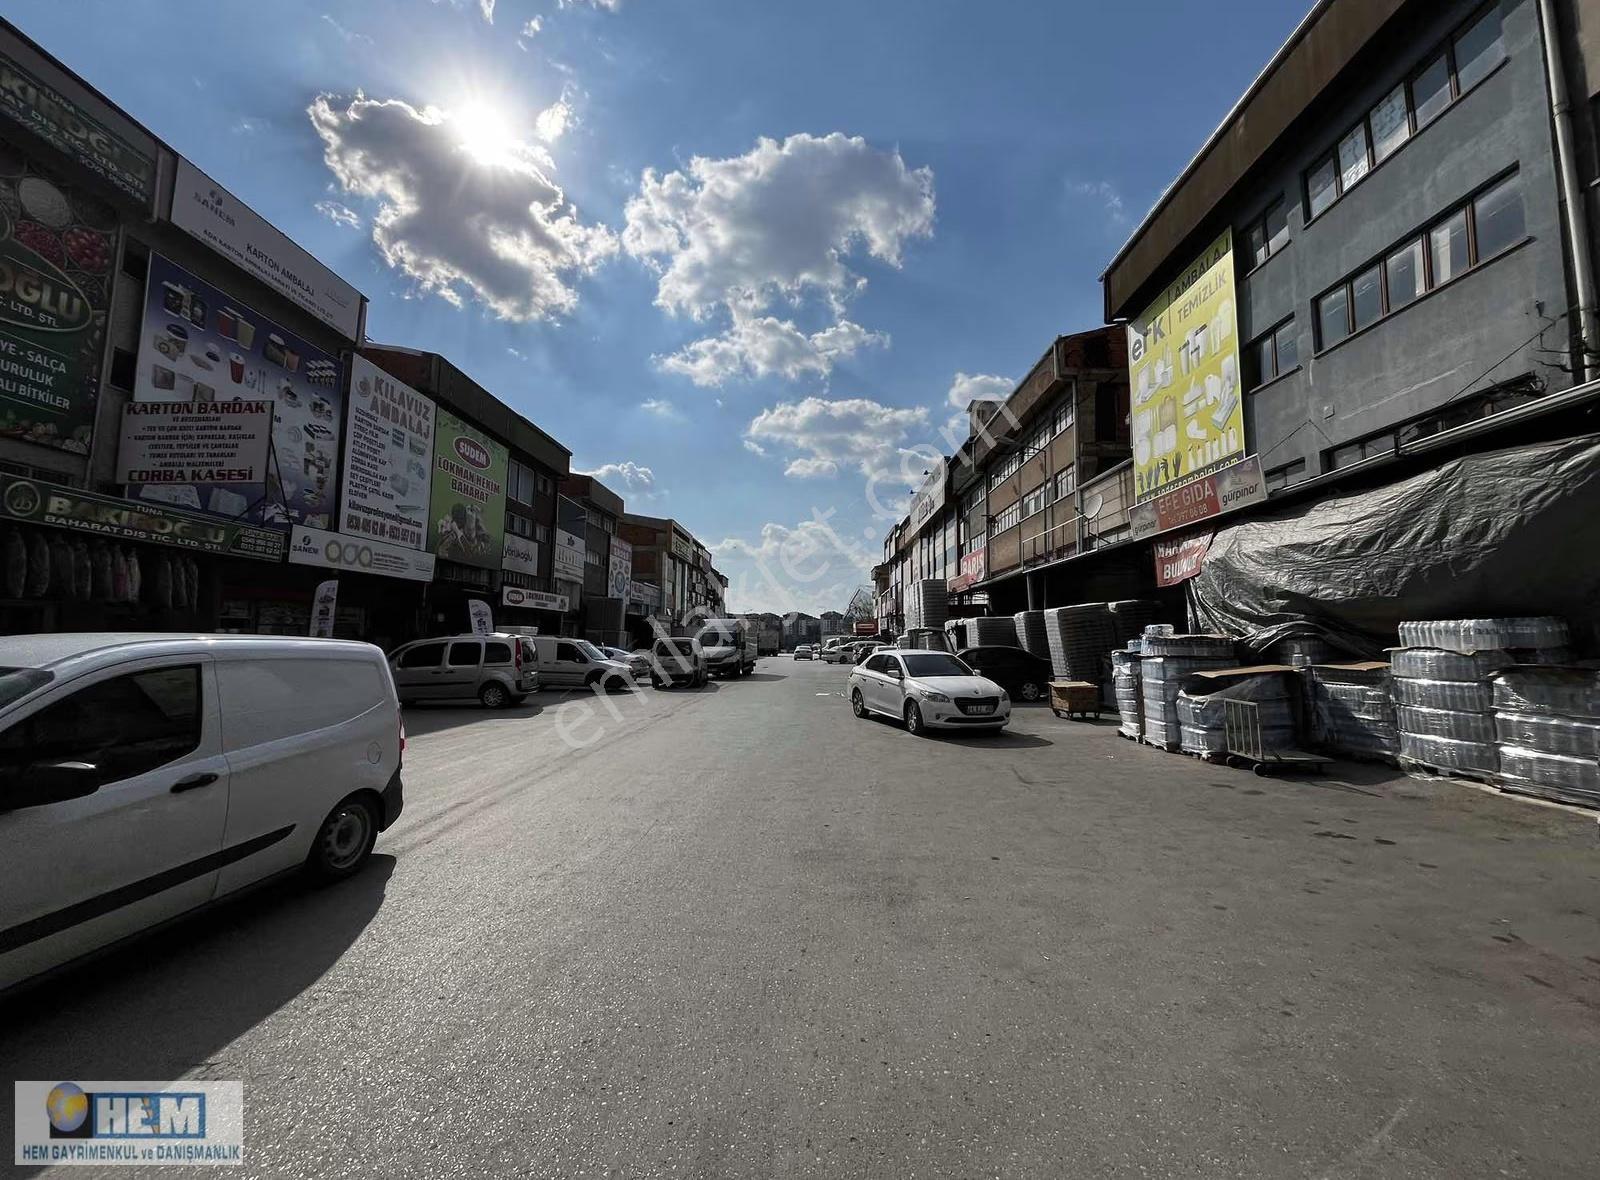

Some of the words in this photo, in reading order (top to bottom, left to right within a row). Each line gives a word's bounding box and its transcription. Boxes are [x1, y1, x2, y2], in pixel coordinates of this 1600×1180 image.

[245, 242, 280, 273] KARTON
[280, 266, 315, 297] AMBALAJ
[1177, 270, 1228, 324] TEMİZLİK
[26, 350, 67, 374] SALÇA
[126, 402, 194, 415] KARTON
[197, 402, 266, 414] BARDAK
[374, 375, 431, 422] KILAVUZ
[191, 466, 254, 481] KASESİ
[437, 455, 475, 483] LOKMAN
[135, 504, 164, 517] TUNA
[1158, 491, 1182, 515] EFE
[1182, 480, 1215, 506] GIDA
[43, 513, 120, 535] BAHARAT
